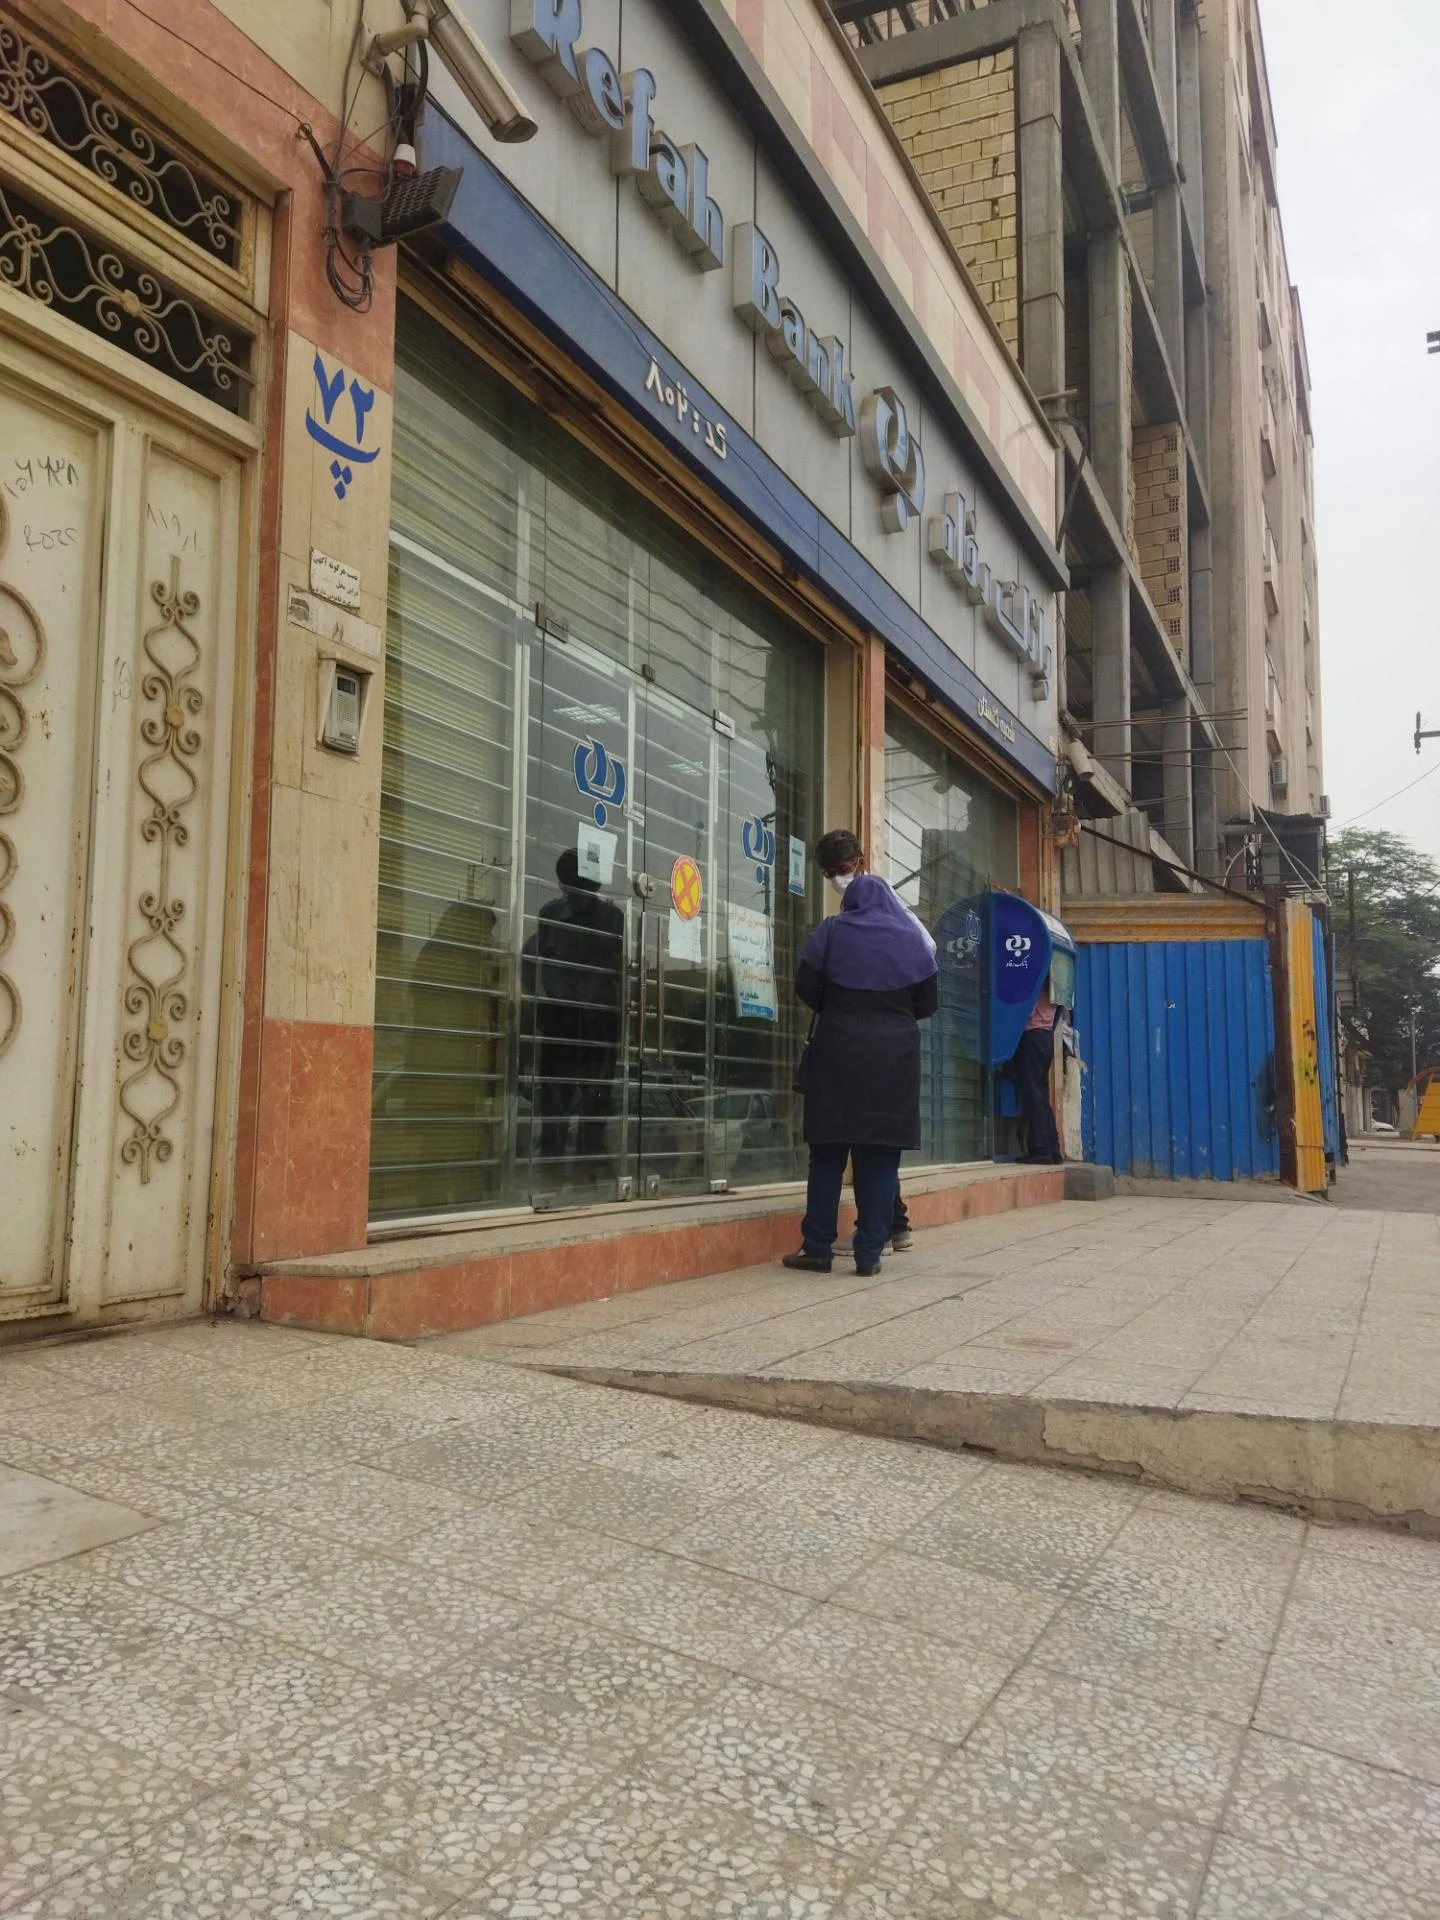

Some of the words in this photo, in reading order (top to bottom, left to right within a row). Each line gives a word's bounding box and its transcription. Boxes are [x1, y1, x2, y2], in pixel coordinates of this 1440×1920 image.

[734, 221, 855, 438] Bank
[313, 352, 375, 445] ۷۲
[312, 556, 328, 565] آگهی
[929, 492, 991, 605] رفاه
[986, 578, 1052, 701] بانک
[1014, 953, 1030, 969] بانک
